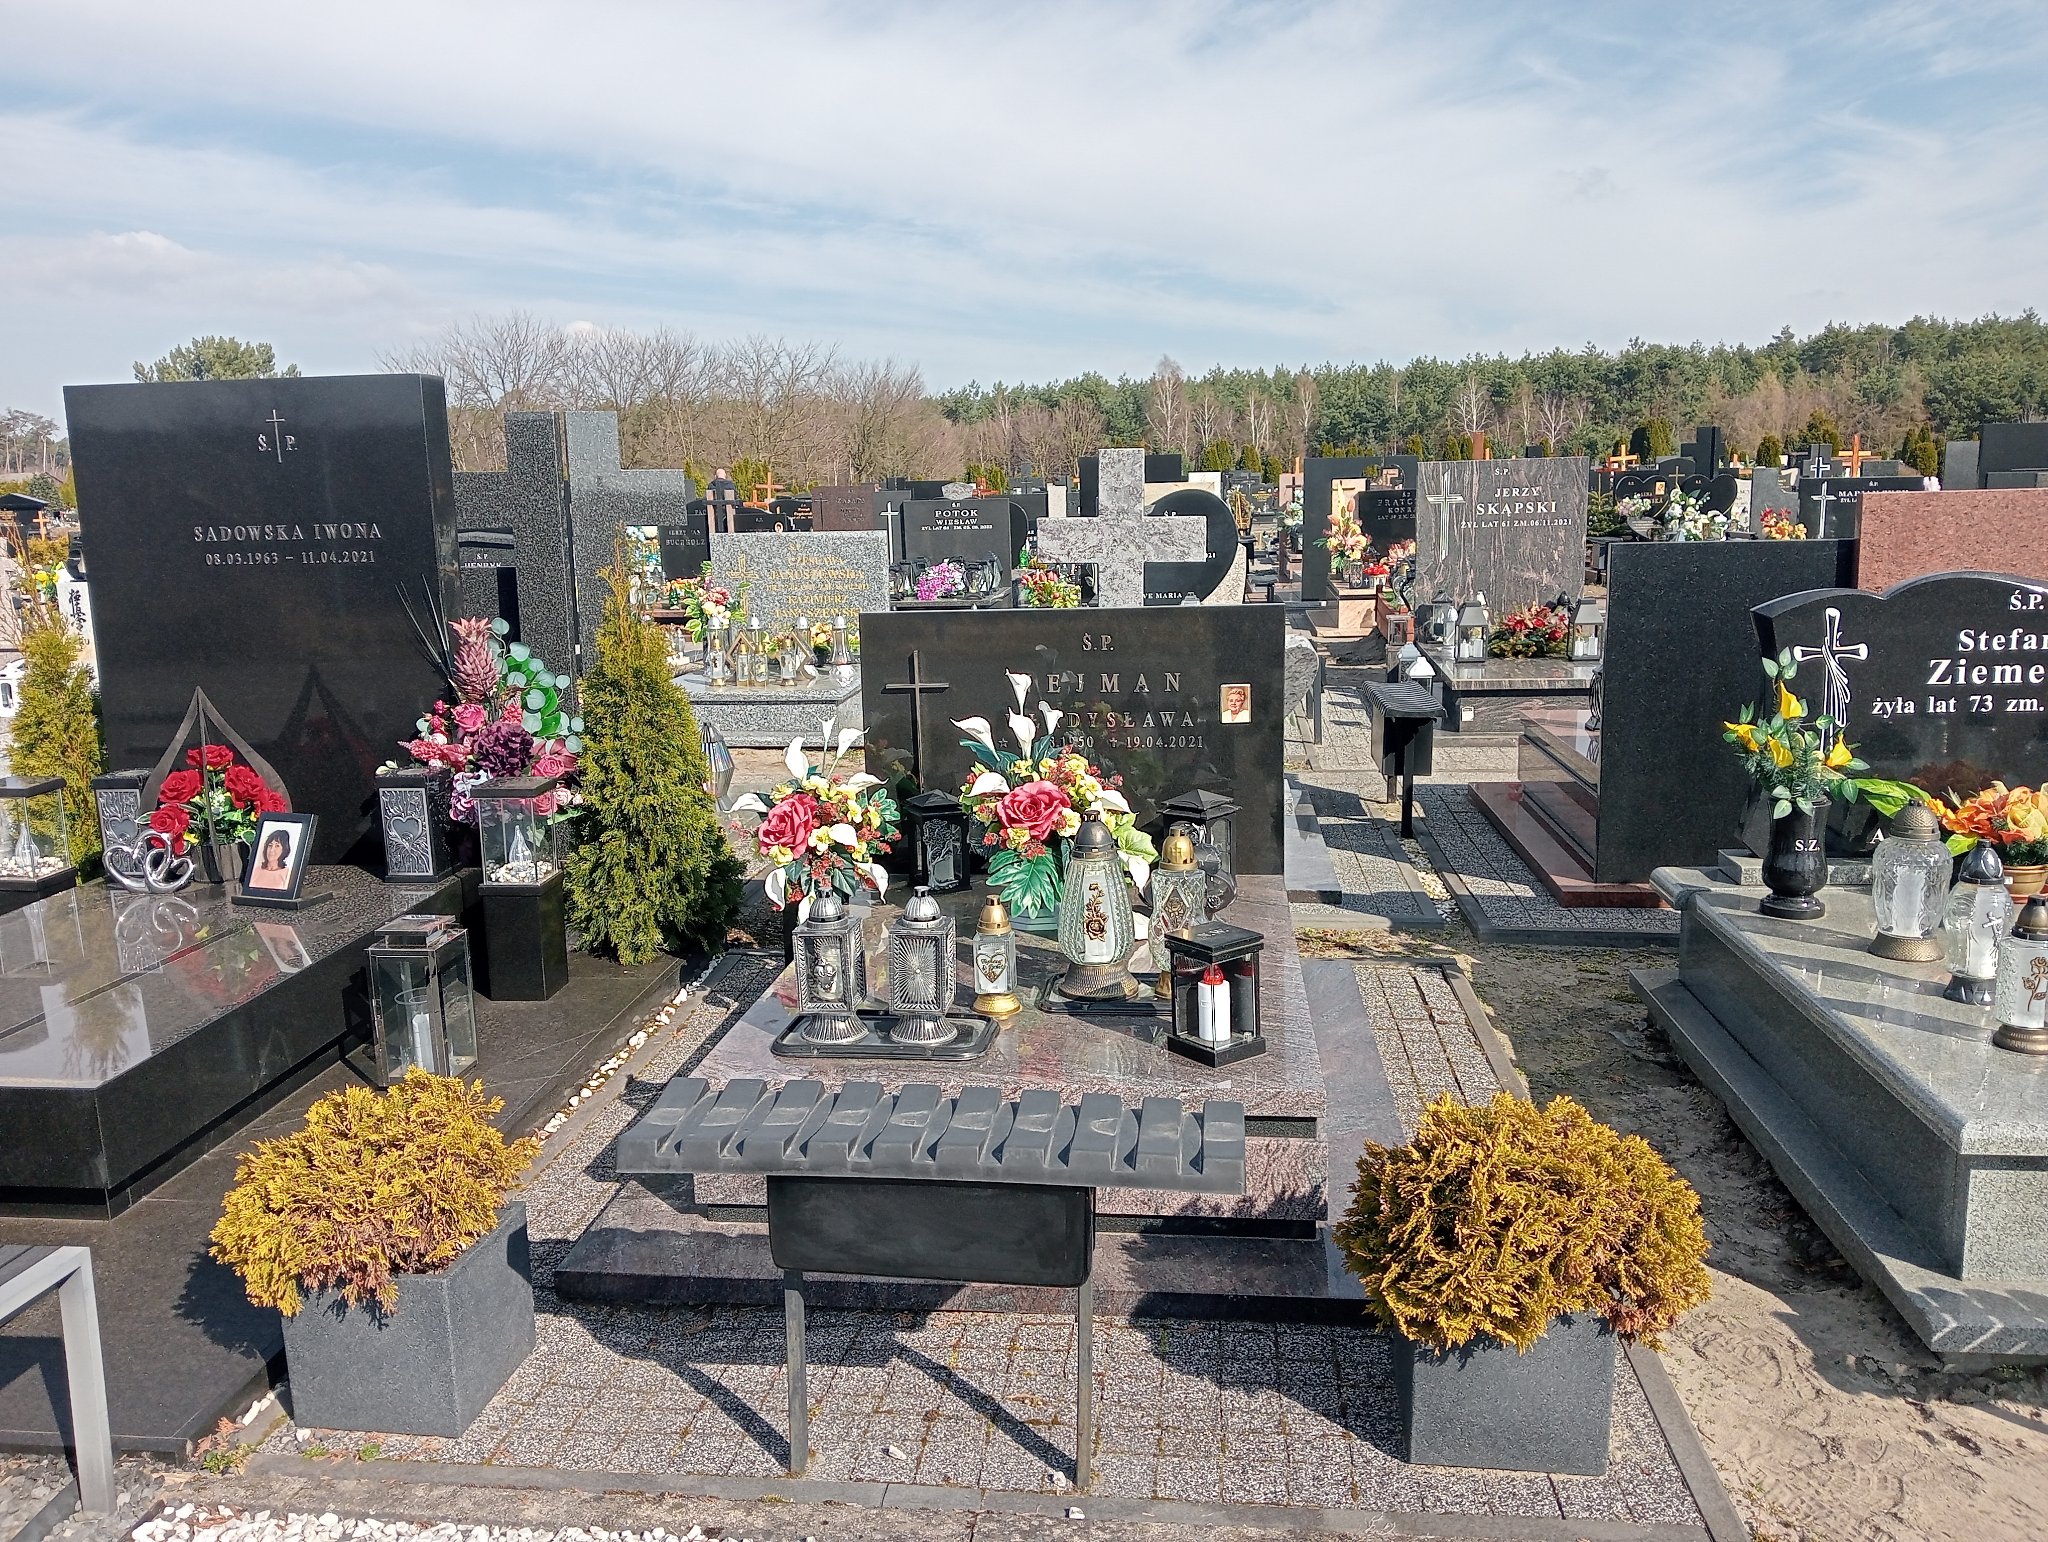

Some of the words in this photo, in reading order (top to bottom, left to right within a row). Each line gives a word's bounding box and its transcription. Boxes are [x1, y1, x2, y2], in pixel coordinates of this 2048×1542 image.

[1494, 486, 1541, 498] JERZY
[934, 509, 978, 518] POTOK
[1476, 501, 1557, 517] SKĄPSKI
[193, 524, 304, 542] SADOWSKA
[313, 522, 382, 540] IWONA
[1482, 520, 1499, 528] LAT
[205, 552, 279, 566] 08.03.1963
[301, 550, 376, 565] 11.04.2021
[1155, 591, 1183, 600] MARIA
[2009, 589, 2045, 610] Ś.P.
[1082, 632, 1114, 651] Ś.P.
[1871, 696, 1916, 719] żyła
[1928, 696, 1958, 713] lat
[1969, 694, 1994, 712] 73
[2006, 698, 2045, 712] zm.
[1126, 735, 1203, 749] 19.04.2021
